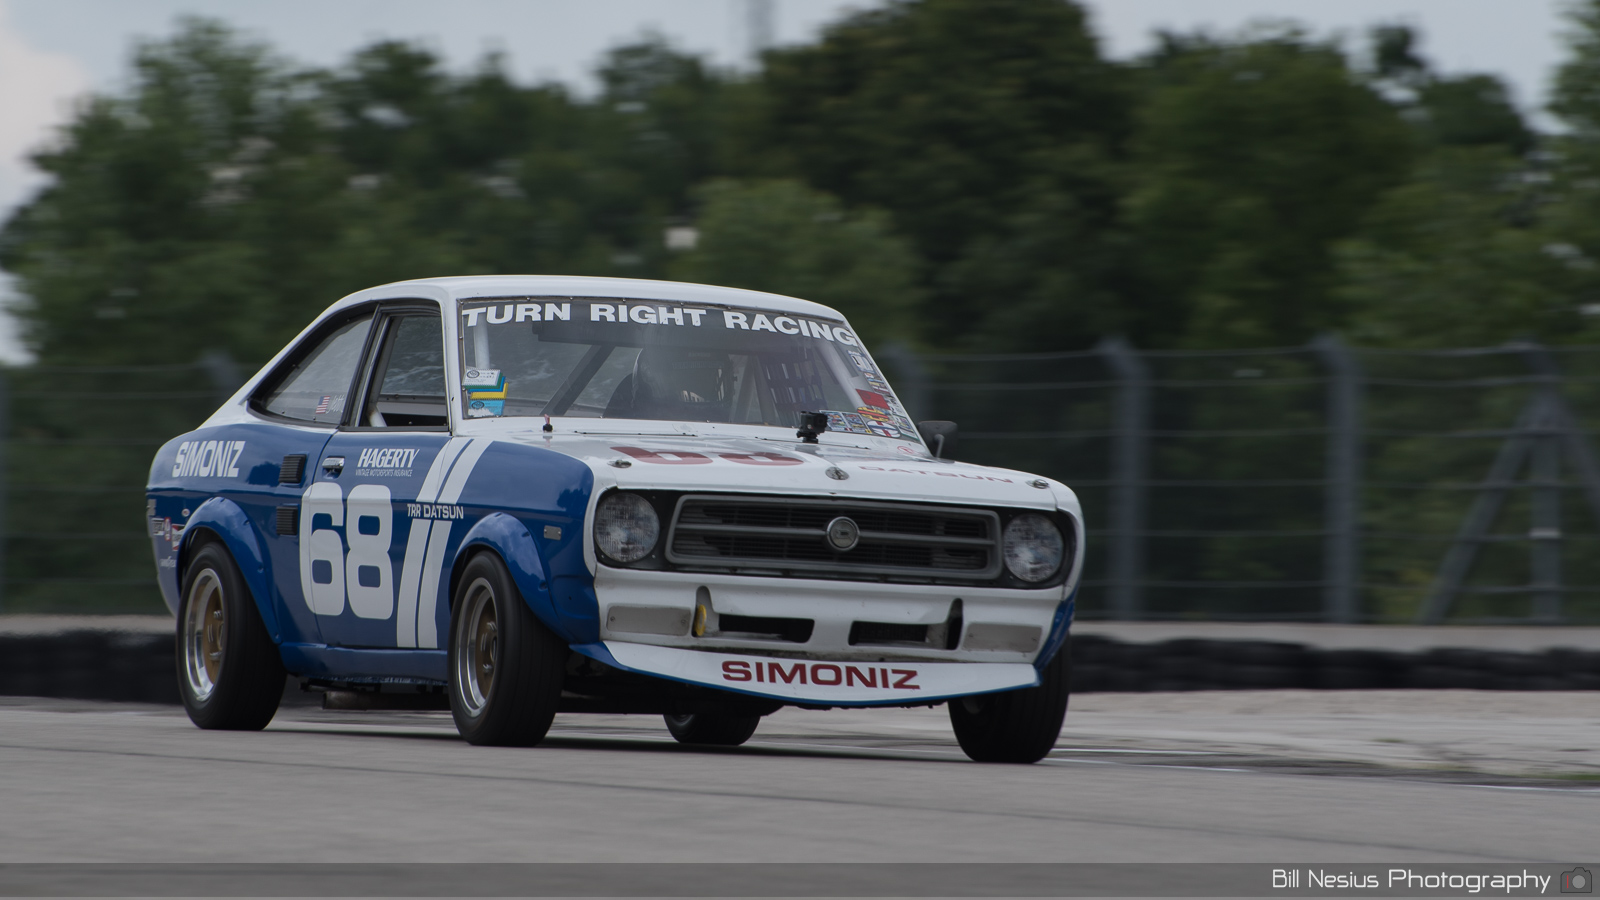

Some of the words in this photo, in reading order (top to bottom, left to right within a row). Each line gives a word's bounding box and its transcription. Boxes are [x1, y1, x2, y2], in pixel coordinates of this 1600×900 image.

[462, 303, 571, 327] TURN
[590, 304, 707, 327] RIGHT
[723, 312, 858, 346] RACING
[171, 440, 246, 478] SIMONIZ
[357, 448, 420, 468] HAGERTY
[355, 468, 370, 477] VINTAGE
[370, 468, 394, 477] MOTORSPORTS
[394, 469, 413, 477] INSURANCE
[859, 465, 1014, 484] DATSUN
[407, 503, 422, 518] TRR
[423, 504, 464, 520] DATSUN
[299, 482, 393, 619] 68
[722, 661, 920, 690] SIMONIZ
